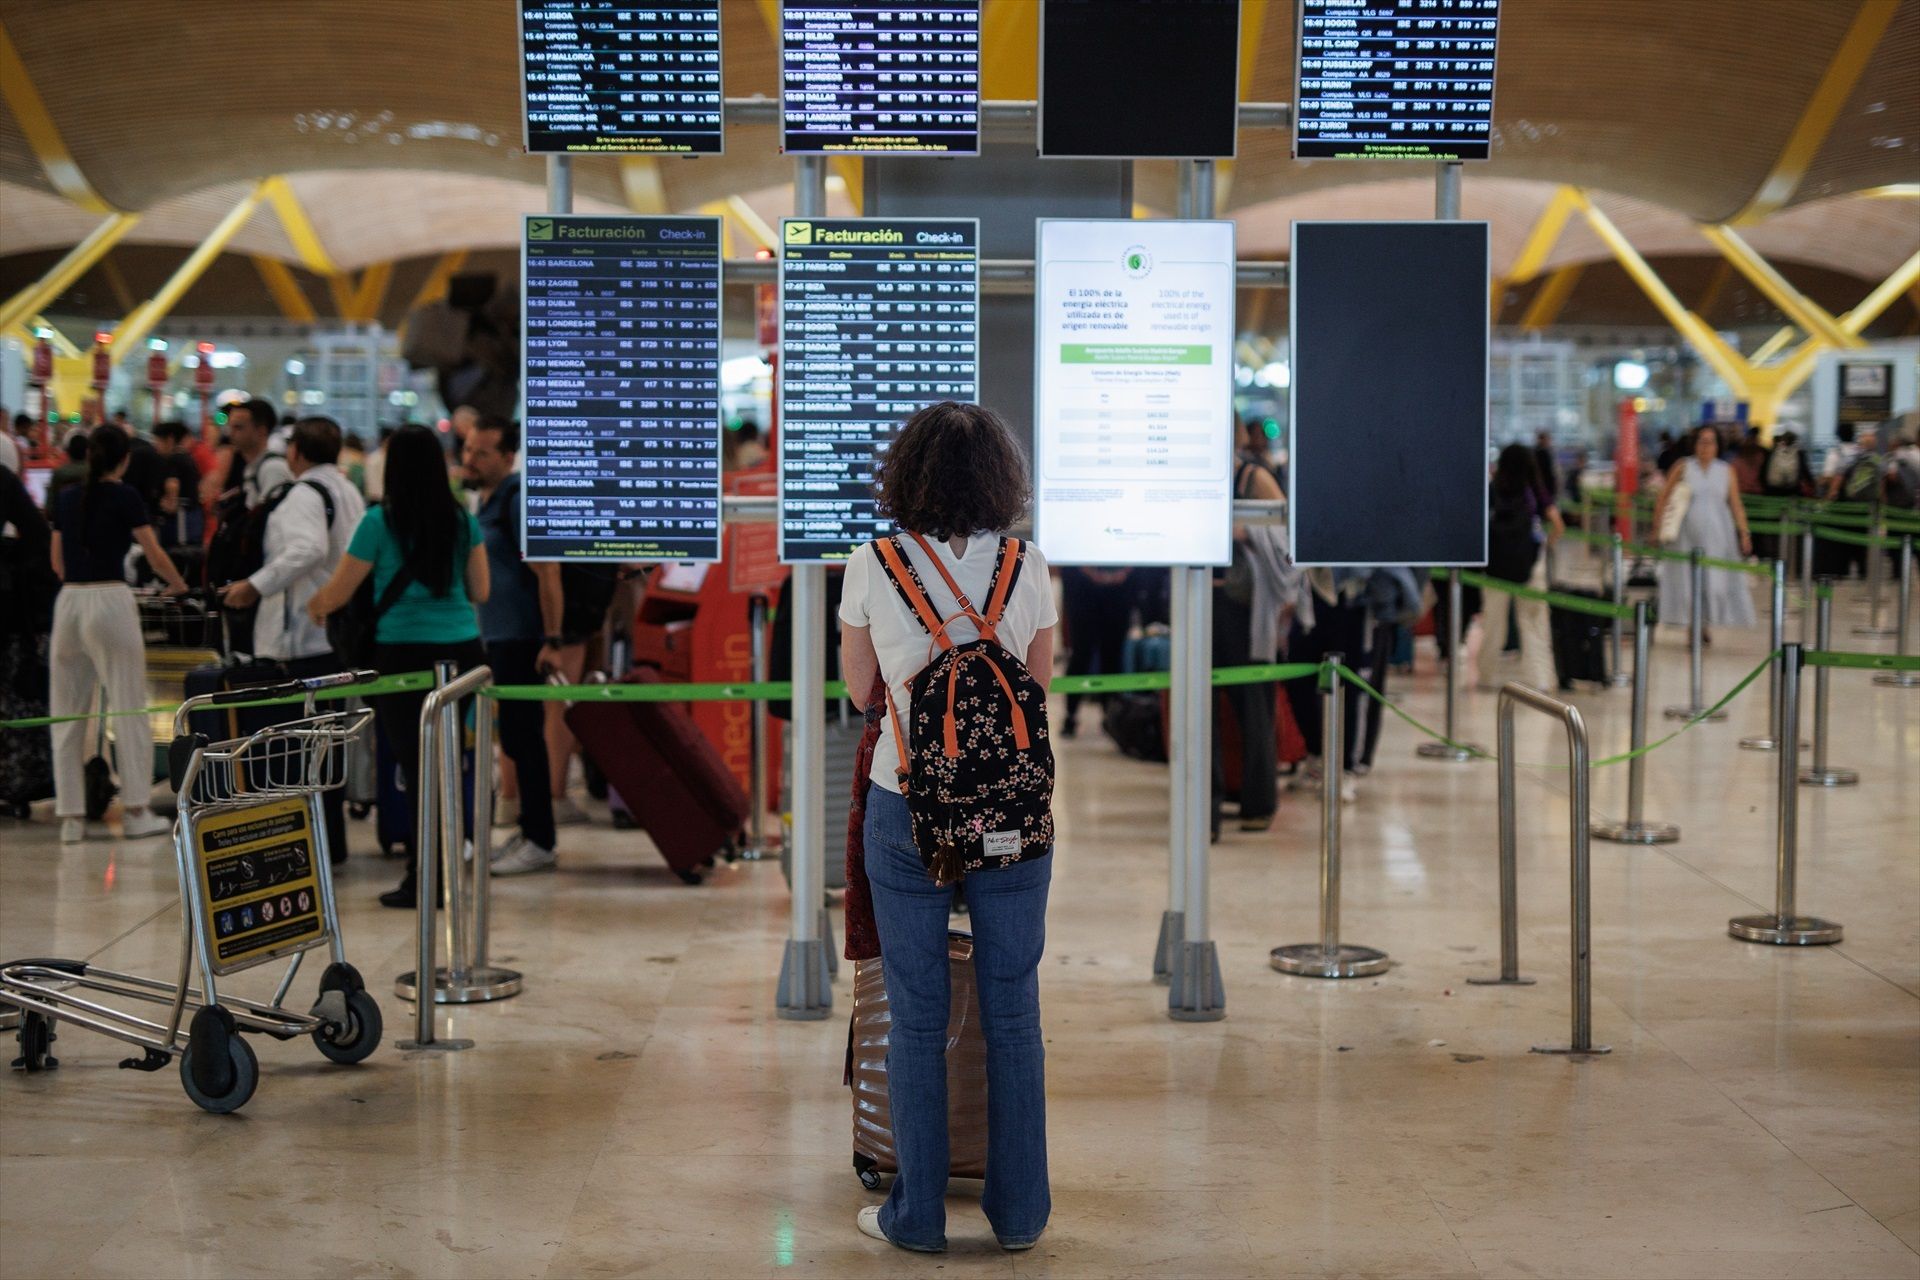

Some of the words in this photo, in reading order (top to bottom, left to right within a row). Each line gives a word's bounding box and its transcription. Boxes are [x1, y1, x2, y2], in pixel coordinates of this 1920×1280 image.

[1442, 0, 1453, 8] T4
[544, 12, 573, 20] LISBOA
[618, 13, 632, 21] IBE
[662, 13, 672, 21] T4
[805, 12, 853, 20] BARCELONA
[1324, 20, 1357, 28] BOGOTA
[1397, 20, 1411, 28] IBE
[1441, 21, 1451, 29] T4
[618, 33, 632, 41] IBE
[663, 33, 673, 41] T4
[805, 33, 834, 41] BILBAO
[1323, 40, 1332, 48] EL
[1334, 40, 1359, 48] CAIRO
[1440, 41, 1450, 49] T4
[526, 53, 545, 61] 15:40
[664, 54, 673, 62] T4
[1322, 61, 1373, 69] DUSSELDORF
[1394, 61, 1408, 70] IBE
[1439, 62, 1449, 70] T4
[527, 73, 546, 81] 15:45
[665, 74, 674, 82] T4
[1321, 81, 1352, 89] MUNICH
[1393, 82, 1407, 90] IBE
[1437, 82, 1447, 90] T4
[547, 94, 589, 102] MARSELLA
[665, 94, 675, 102] T4
[805, 94, 837, 102] DALLAS
[1320, 101, 1354, 110] VENECIA
[1392, 102, 1406, 110] IBE
[1436, 102, 1446, 110] T4
[529, 114, 548, 122] 15:45
[621, 114, 635, 122] IBE
[665, 115, 675, 123] T4
[806, 114, 851, 122] LANZAROTE
[1319, 122, 1348, 130] ZURICH
[1435, 123, 1445, 131] T4
[558, 225, 645, 239] Facturación
[659, 229, 706, 240] Check-in
[815, 229, 903, 243] Facturación
[916, 232, 964, 244] Check-in
[527, 260, 546, 268] 16:45
[548, 260, 594, 268] BARCELONA
[1069, 289, 1077, 297] El
[1079, 289, 1101, 297] 100%
[1103, 289, 1113, 297] de
[1115, 289, 1122, 297] la
[1159, 290, 1180, 298] 100%
[1182, 289, 1190, 298] of
[1192, 290, 1204, 298] the
[527, 300, 546, 308] 16:50
[548, 300, 575, 308] DUBLIN
[1152, 301, 1184, 309] electrical
[1186, 303, 1211, 311] energy
[1067, 311, 1101, 319] utilizada
[1115, 311, 1124, 319] de
[1164, 312, 1181, 320] used
[1191, 312, 1199, 320] of
[548, 320, 596, 328] LONDRES-HR
[1062, 322, 1087, 331] origen
[1090, 321, 1128, 330] renovable
[1151, 322, 1188, 331] renewable
[1190, 323, 1212, 332] origin
[548, 340, 568, 348] LYON
[548, 360, 586, 368] MENORCA
[620, 361, 633, 369] IBS
[620, 381, 630, 389] AV
[548, 400, 578, 408] ATENAS
[620, 500, 635, 508] VLG
